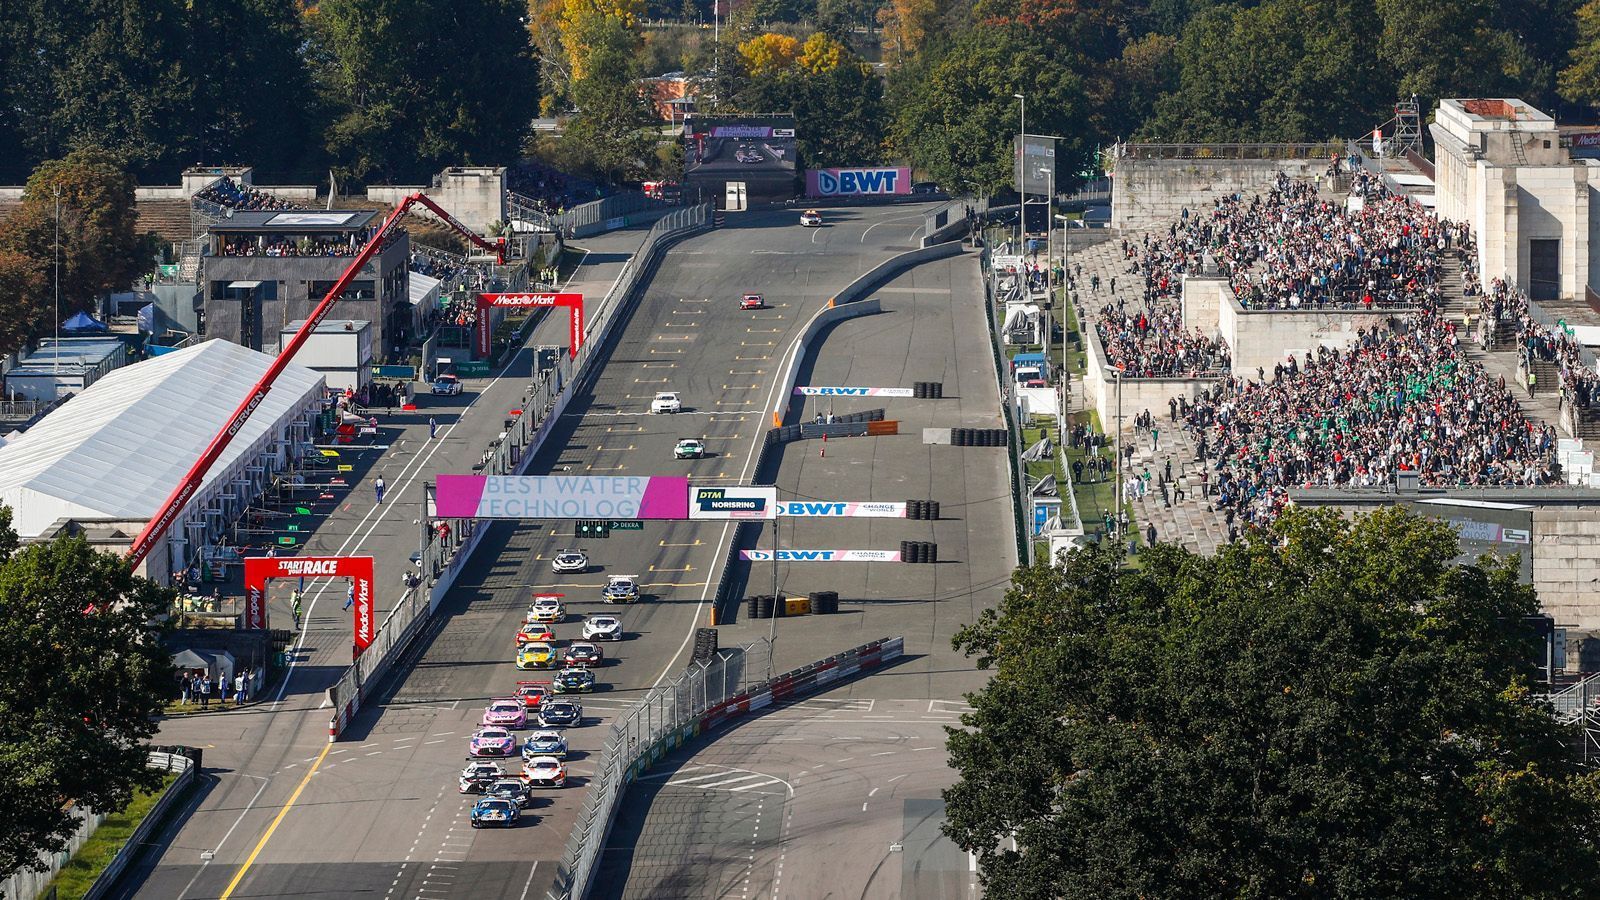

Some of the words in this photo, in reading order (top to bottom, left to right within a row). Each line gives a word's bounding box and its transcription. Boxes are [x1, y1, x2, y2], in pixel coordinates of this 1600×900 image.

[839, 170, 898, 194] BWT
[820, 387, 869, 396] BWT
[228, 391, 264, 436] GERKEN
[487, 476, 547, 494] BEST
[555, 476, 642, 494] WATER
[475, 499, 650, 518] TECHNOLOGY
[711, 501, 756, 509] NORISRING
[788, 503, 847, 515] BWT
[775, 551, 834, 560] BWT
[278, 561, 304, 570] START
[303, 560, 338, 574] RACE
